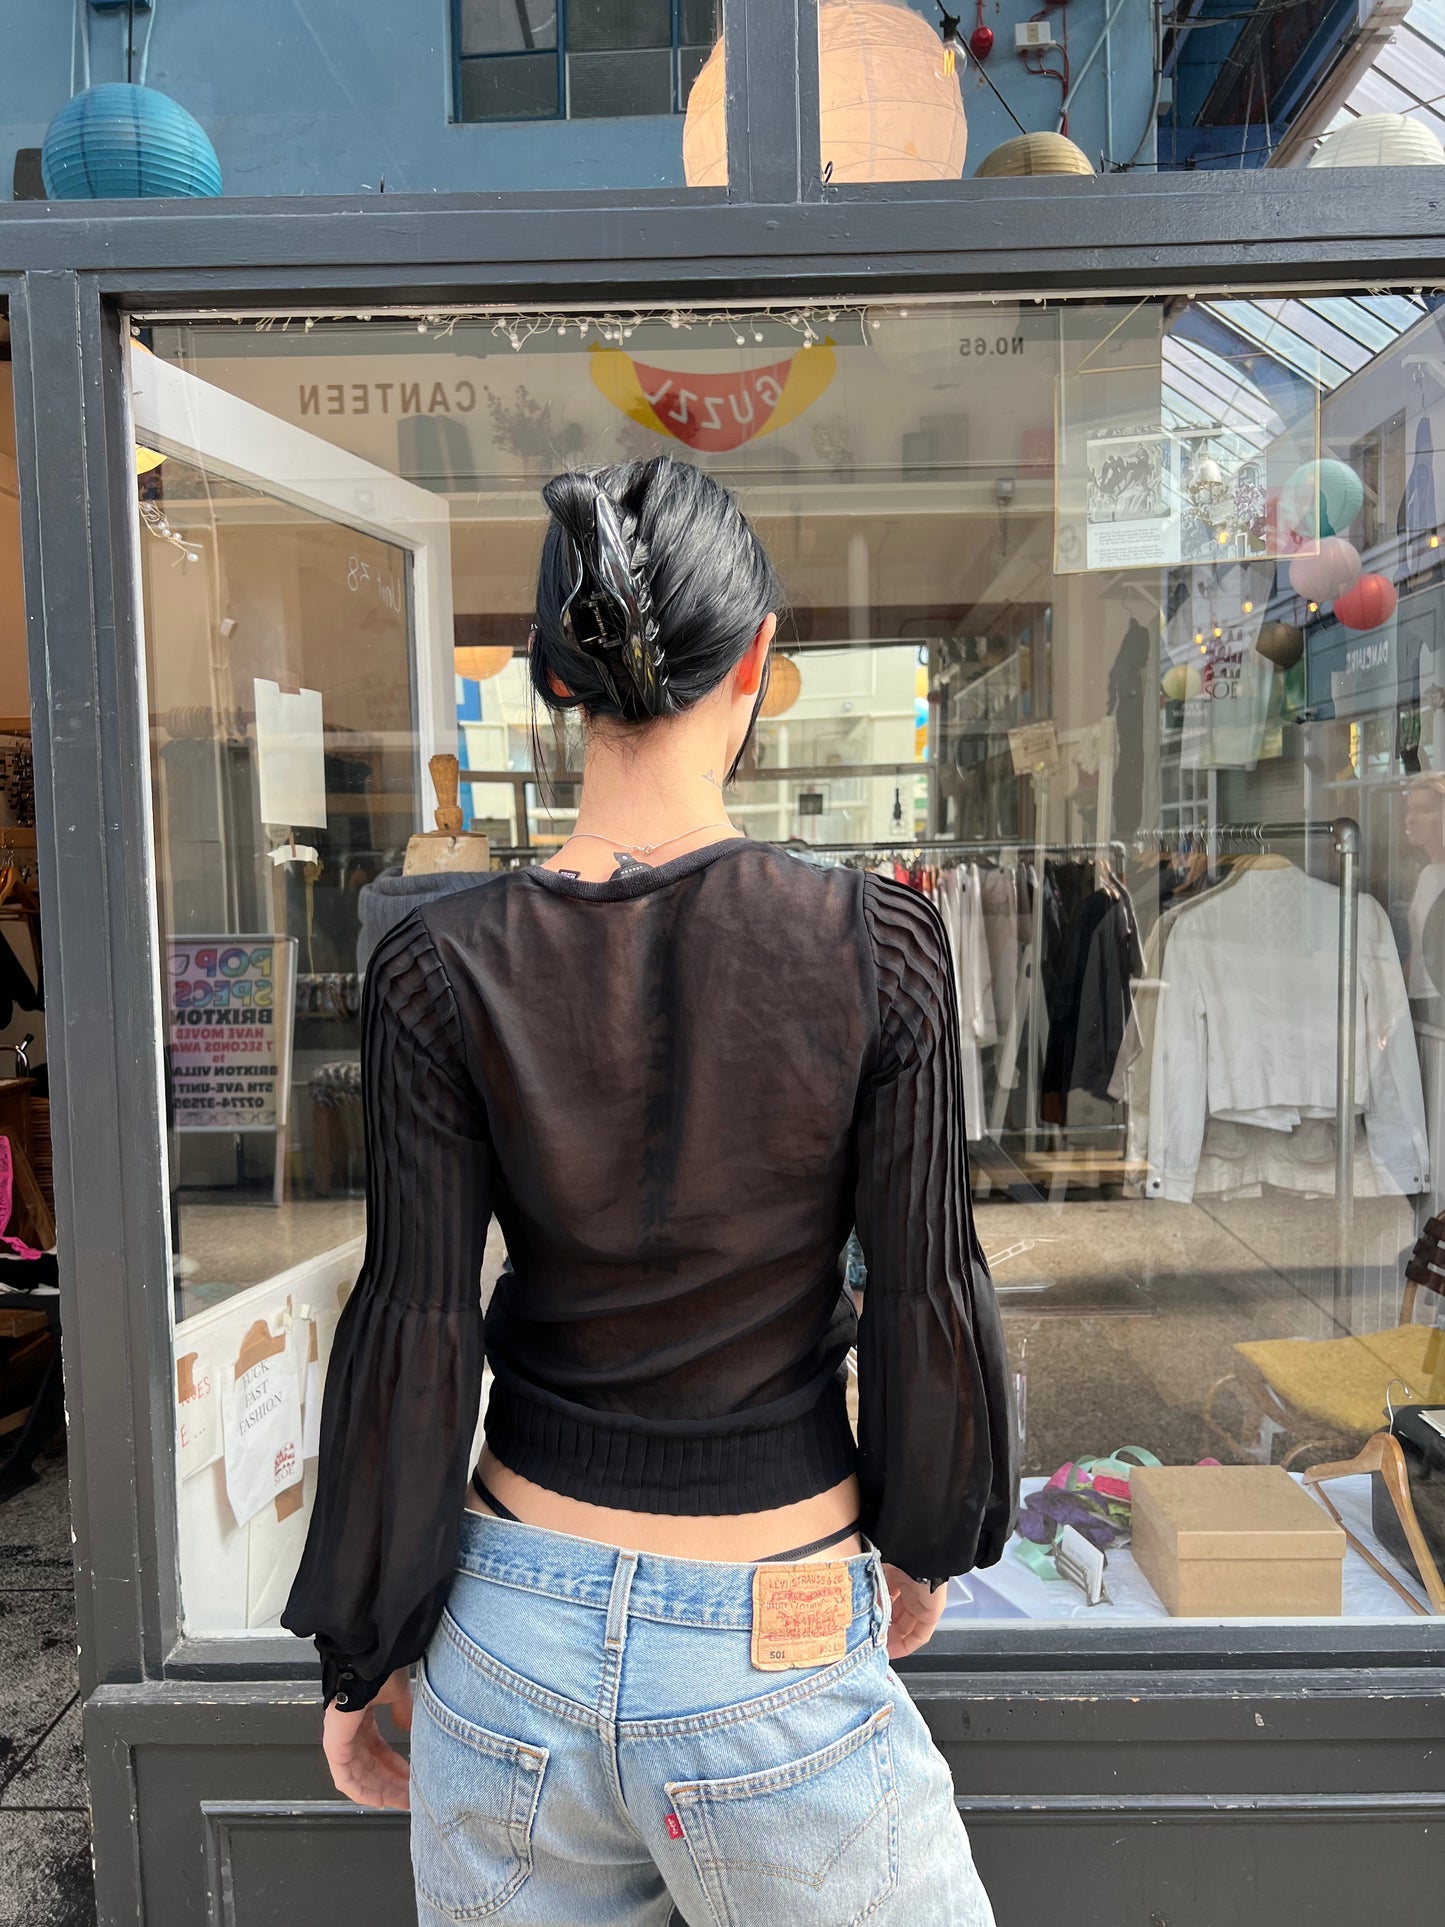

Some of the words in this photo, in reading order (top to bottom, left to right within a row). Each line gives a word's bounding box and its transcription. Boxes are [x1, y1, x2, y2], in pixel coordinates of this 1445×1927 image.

[244, 1379, 269, 1408] FAST
[239, 1391, 283, 1436] FASHION
[792, 1574, 825, 1587] STRAUSS
[769, 1651, 785, 1659] 501
